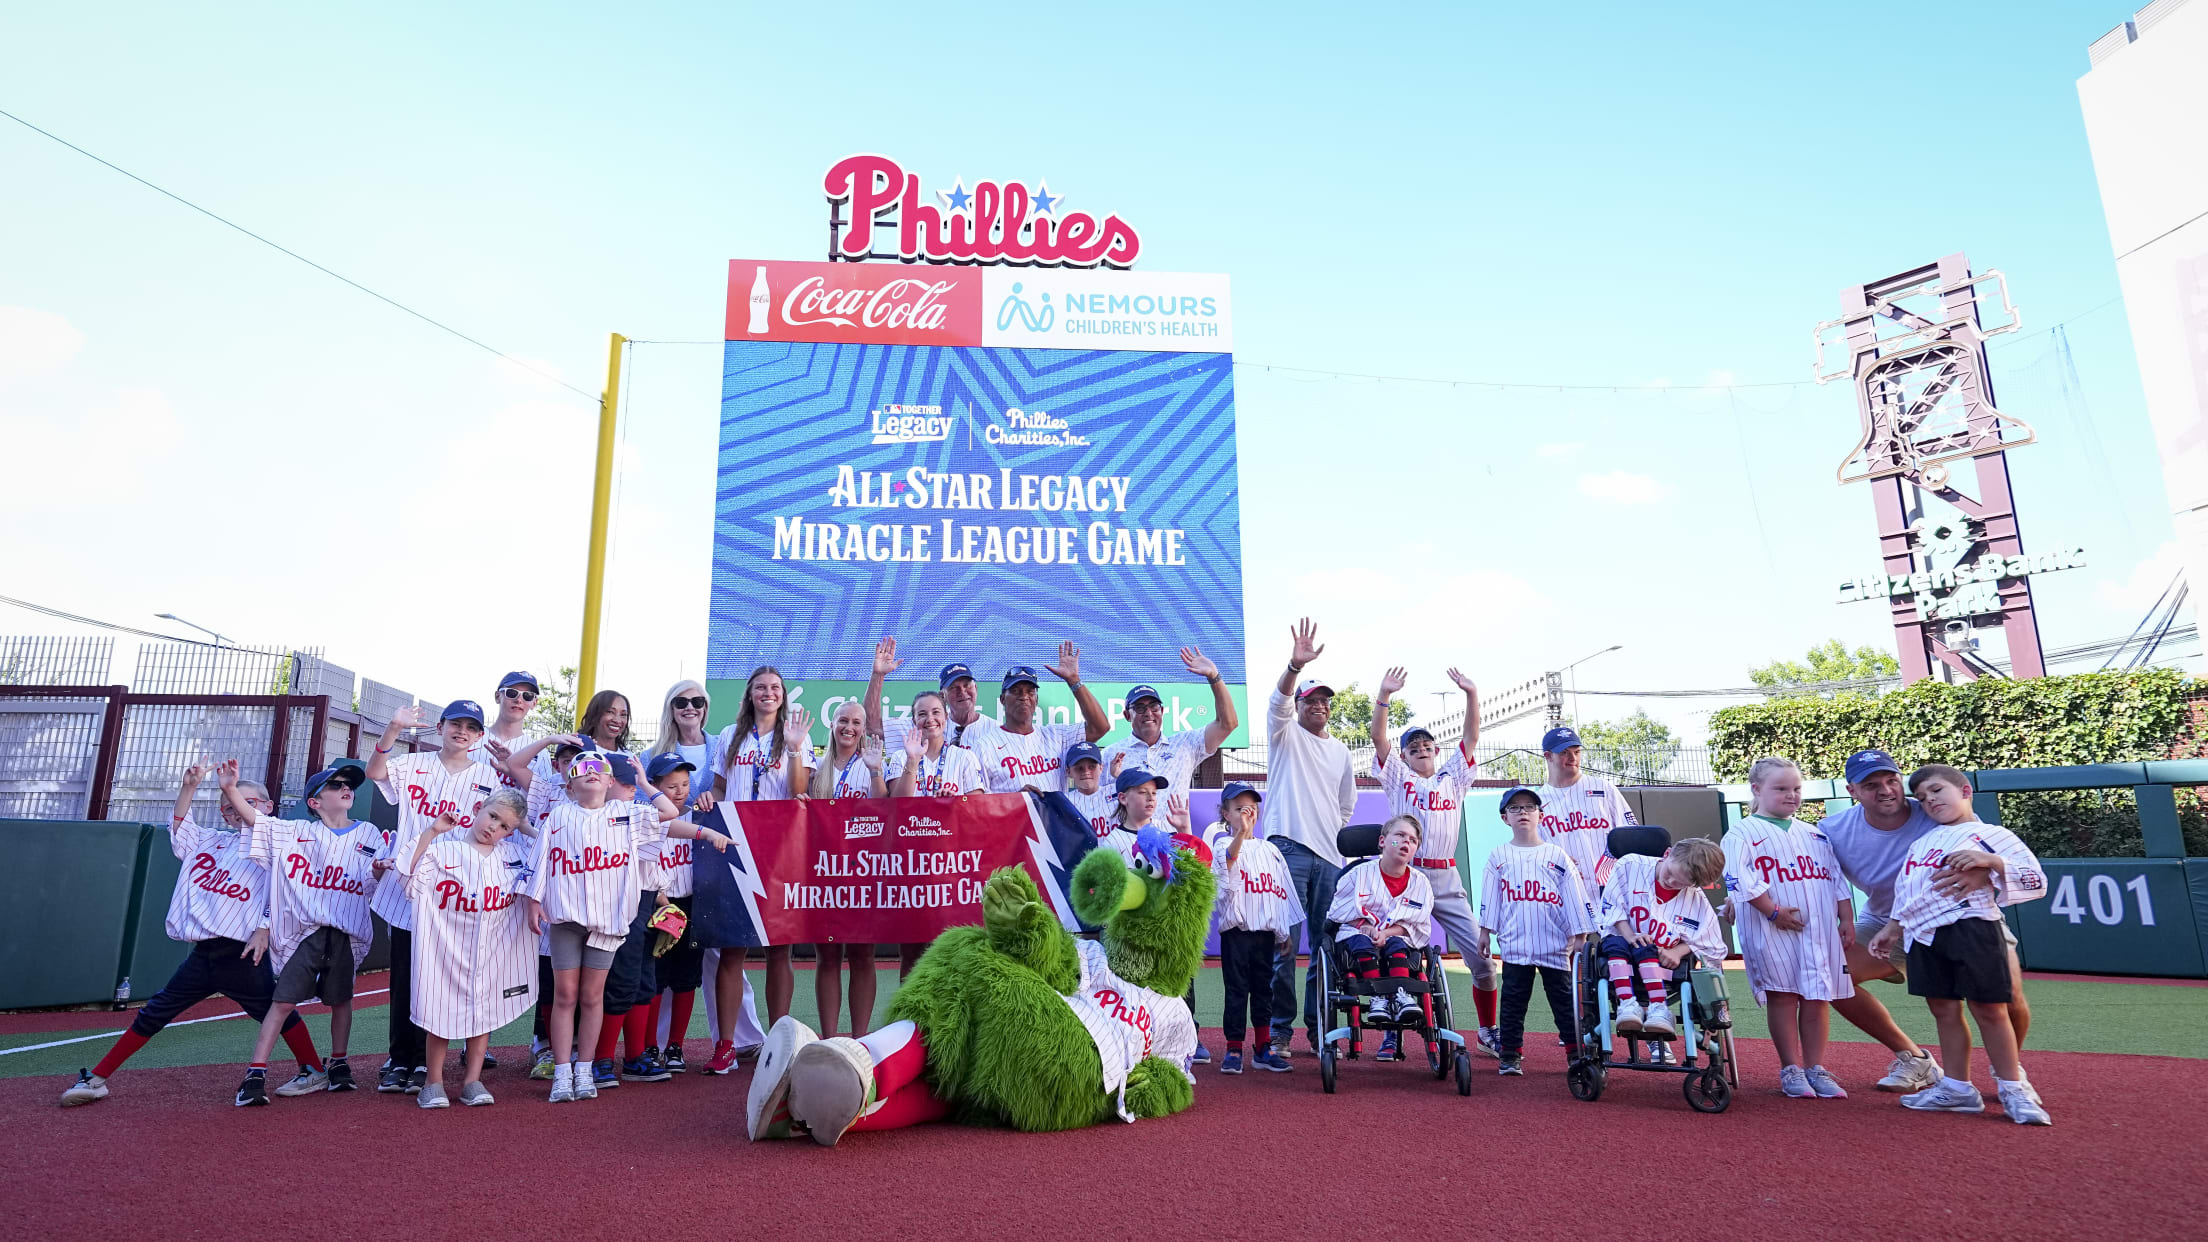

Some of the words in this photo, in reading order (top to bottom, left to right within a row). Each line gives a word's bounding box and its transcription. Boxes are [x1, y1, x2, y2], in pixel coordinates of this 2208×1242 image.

[823, 153, 1142, 266] Phillies
[781, 276, 959, 330] Coca-Cola
[1065, 293, 1217, 317] NEMOURS
[1065, 319, 1157, 336] CHILDREN'S
[1161, 322, 1218, 337] HEALTH
[871, 411, 953, 439] Legacy
[902, 405, 942, 415] TOGETHER
[1006, 408, 1069, 430] Phillies
[999, 468, 1132, 512] LEGACY
[771, 516, 932, 562] MIRACLE
[940, 519, 1079, 564] LEAGUE
[1087, 521, 1186, 566] GAME
[1976, 546, 2087, 581] Bank
[1916, 581, 2001, 620] Park
[407, 784, 473, 829] Phile
[908, 815, 942, 828] Phillies
[844, 820, 885, 836] Legacy
[1542, 811, 1610, 837] Phillies
[549, 846, 630, 878] Phillies
[659, 843, 693, 871] hill
[907, 849, 983, 876] LEGACY
[189, 852, 251, 902] Phllies
[287, 853, 364, 896] Phillies
[1240, 869, 1288, 900] hillies
[783, 882, 872, 910] MIRACLE
[876, 881, 953, 909] LEAGUE
[957, 877, 984, 905] GA
[2051, 874, 2157, 926] 401
